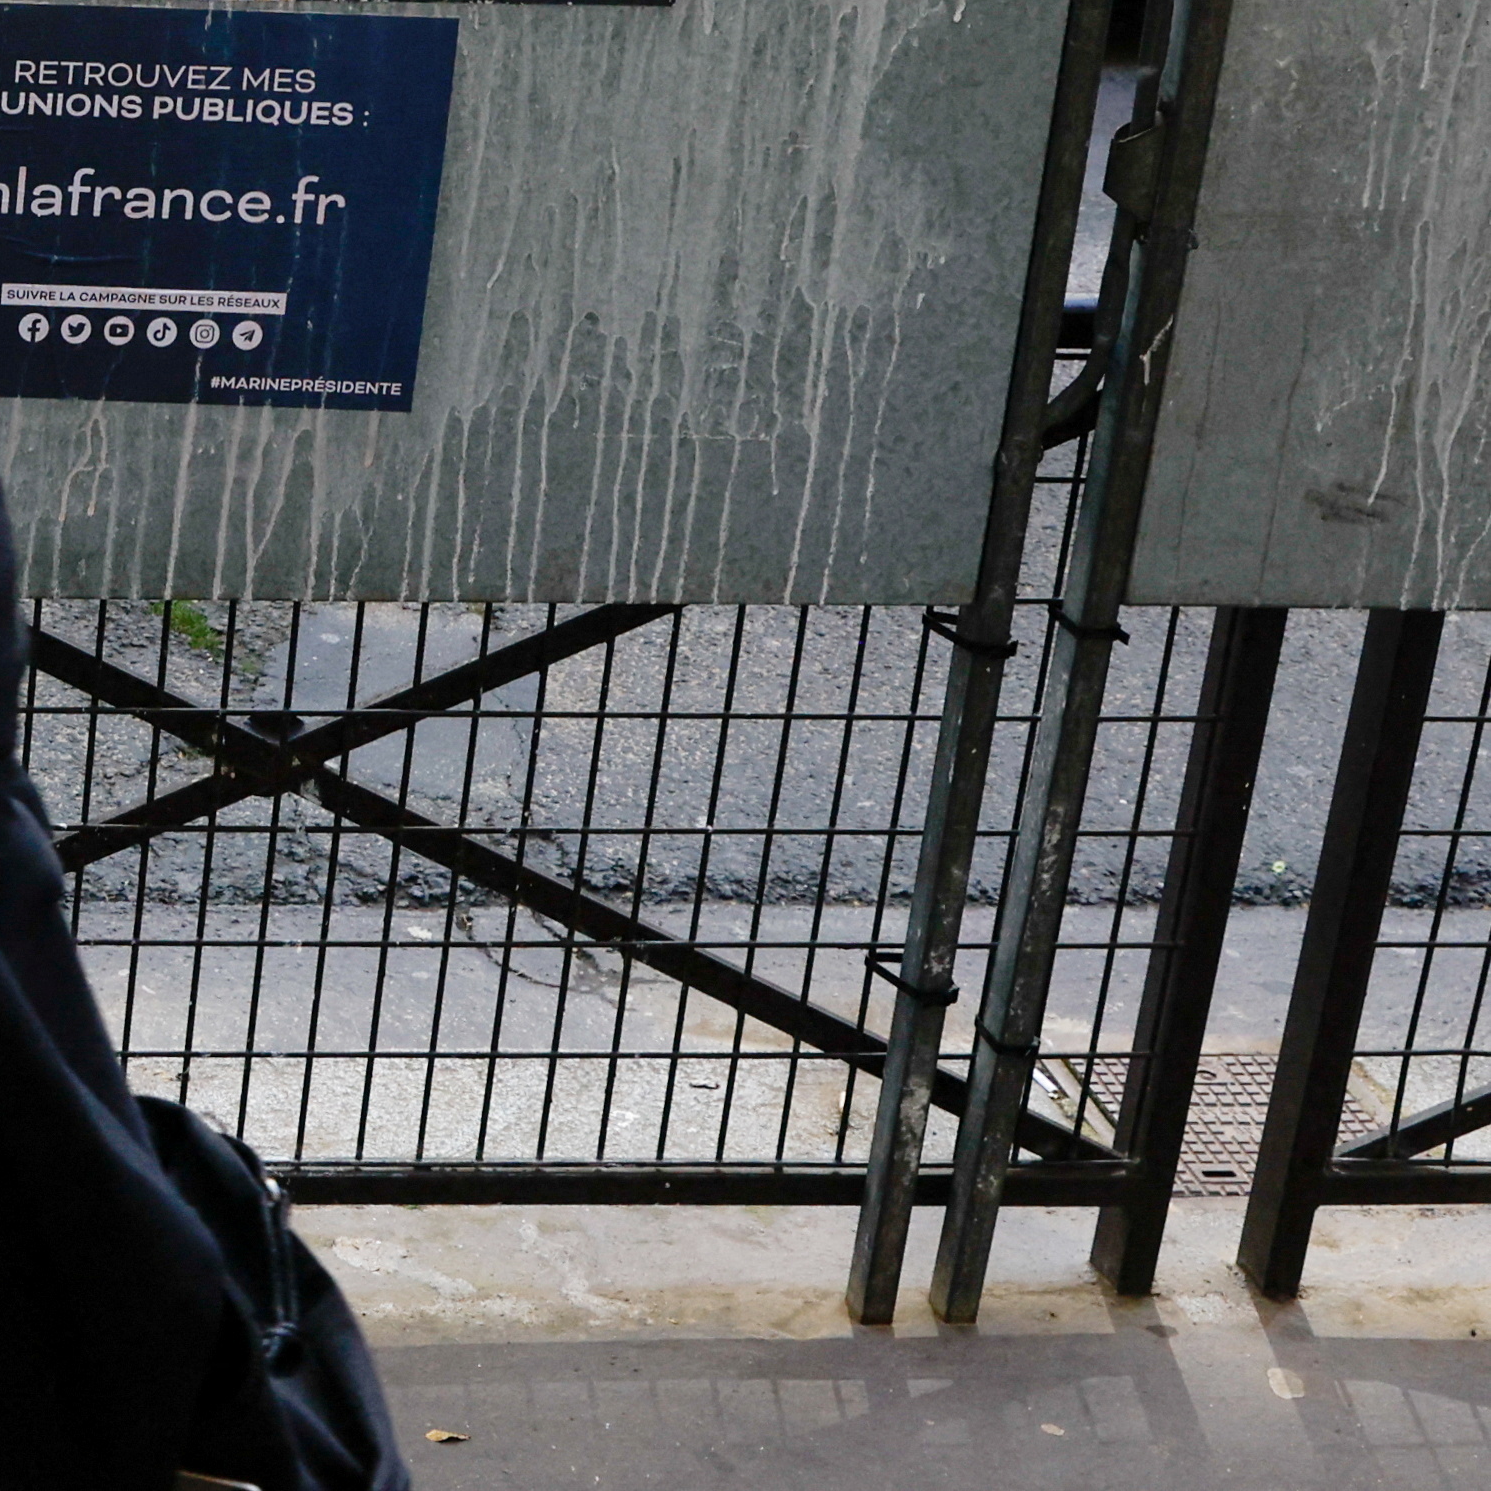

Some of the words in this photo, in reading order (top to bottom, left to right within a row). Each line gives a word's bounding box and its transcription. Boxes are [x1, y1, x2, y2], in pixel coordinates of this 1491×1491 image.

[13, 59, 231, 91] RETROUVEZ
[242, 67, 316, 94] MES
[152, 95, 354, 126] PUBLIQUES
[7, 289, 57, 301] SUIVRE
[59, 291, 76, 302] LA
[79, 292, 157, 305] CAMPAGNE
[159, 294, 187, 305] SUR
[190, 295, 214, 307] LES
[217, 294, 280, 309] RÉSEAUX
[210, 375, 402, 395] #MARINEPRÉSIDENTE
